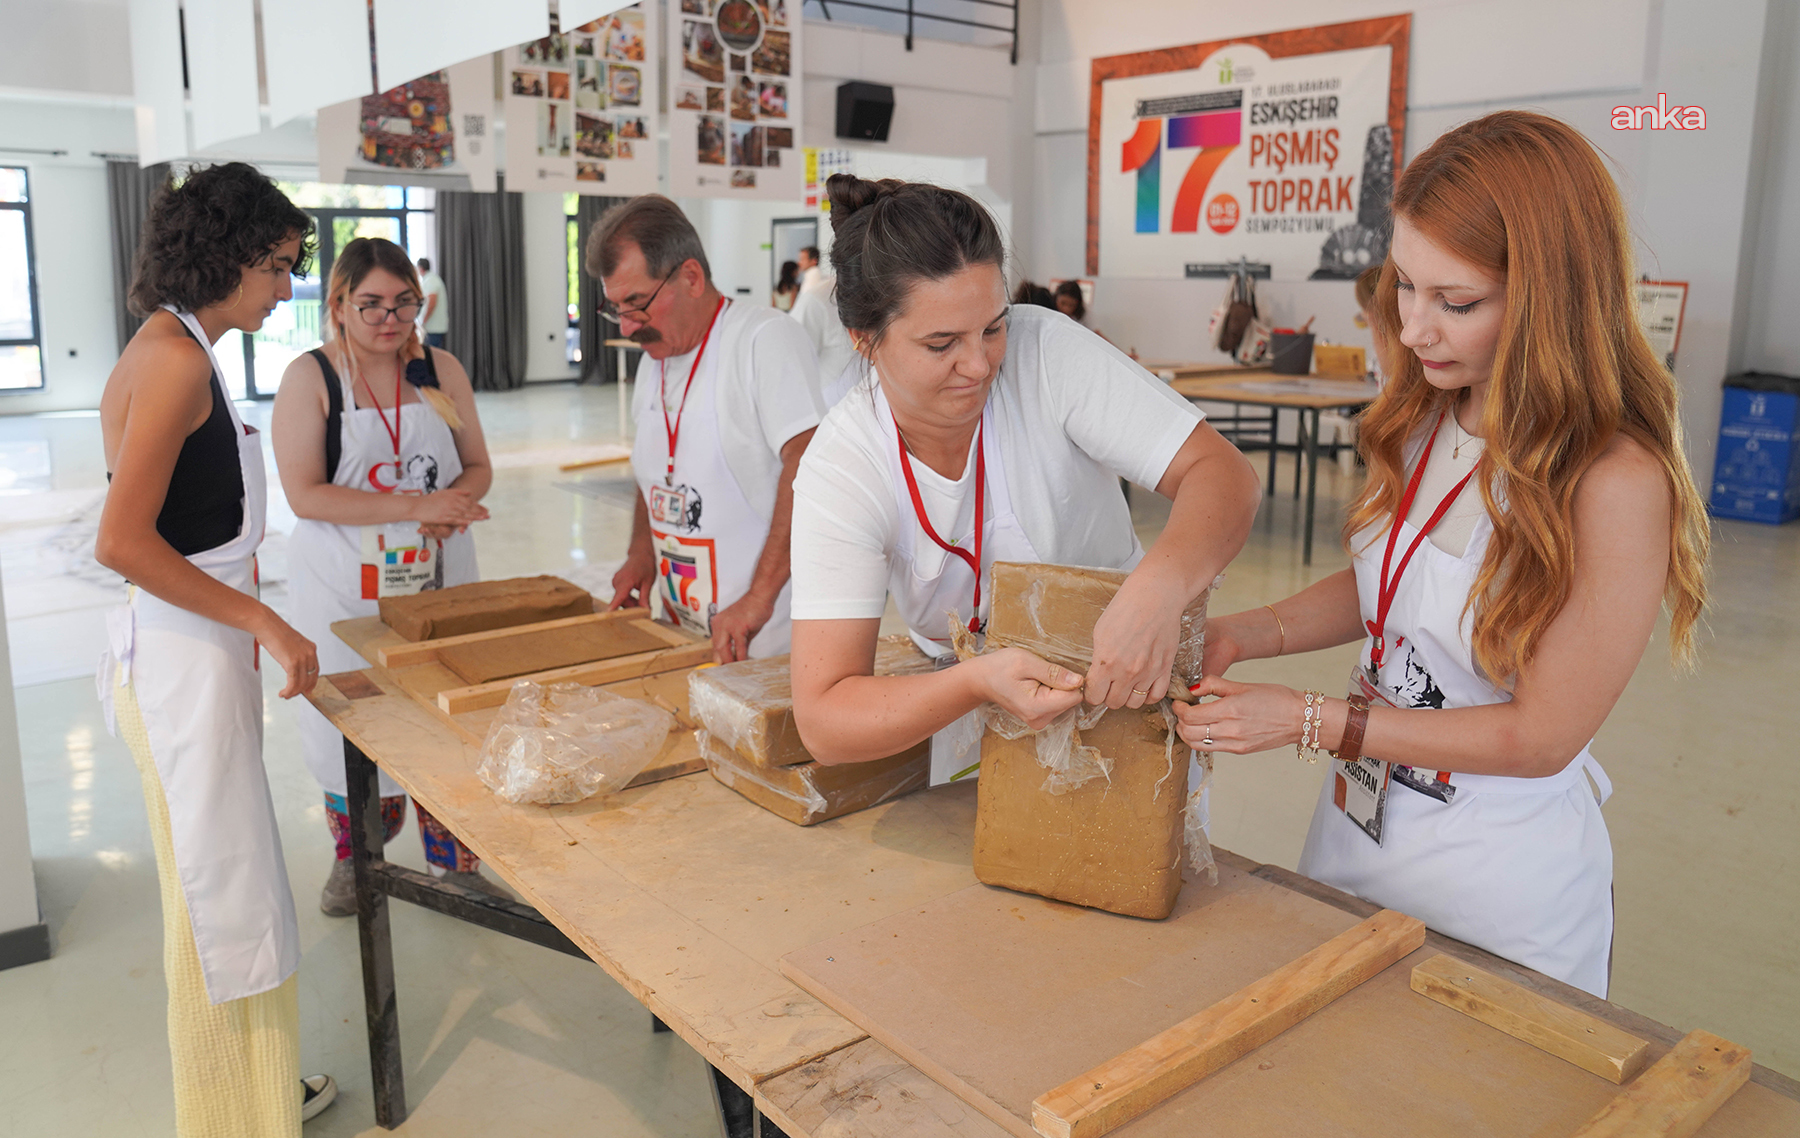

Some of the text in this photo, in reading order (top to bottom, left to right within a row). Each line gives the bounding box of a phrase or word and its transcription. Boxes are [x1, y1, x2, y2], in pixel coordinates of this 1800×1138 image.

[1267, 79, 1340, 96] ULUSLARARASI
[1251, 97, 1338, 126] ESKİŞEHİR
[1250, 128, 1340, 173] PİŞMİŞ
[1249, 176, 1354, 213] TOPRAK
[1245, 217, 1335, 234] SEMPOZYUMU
